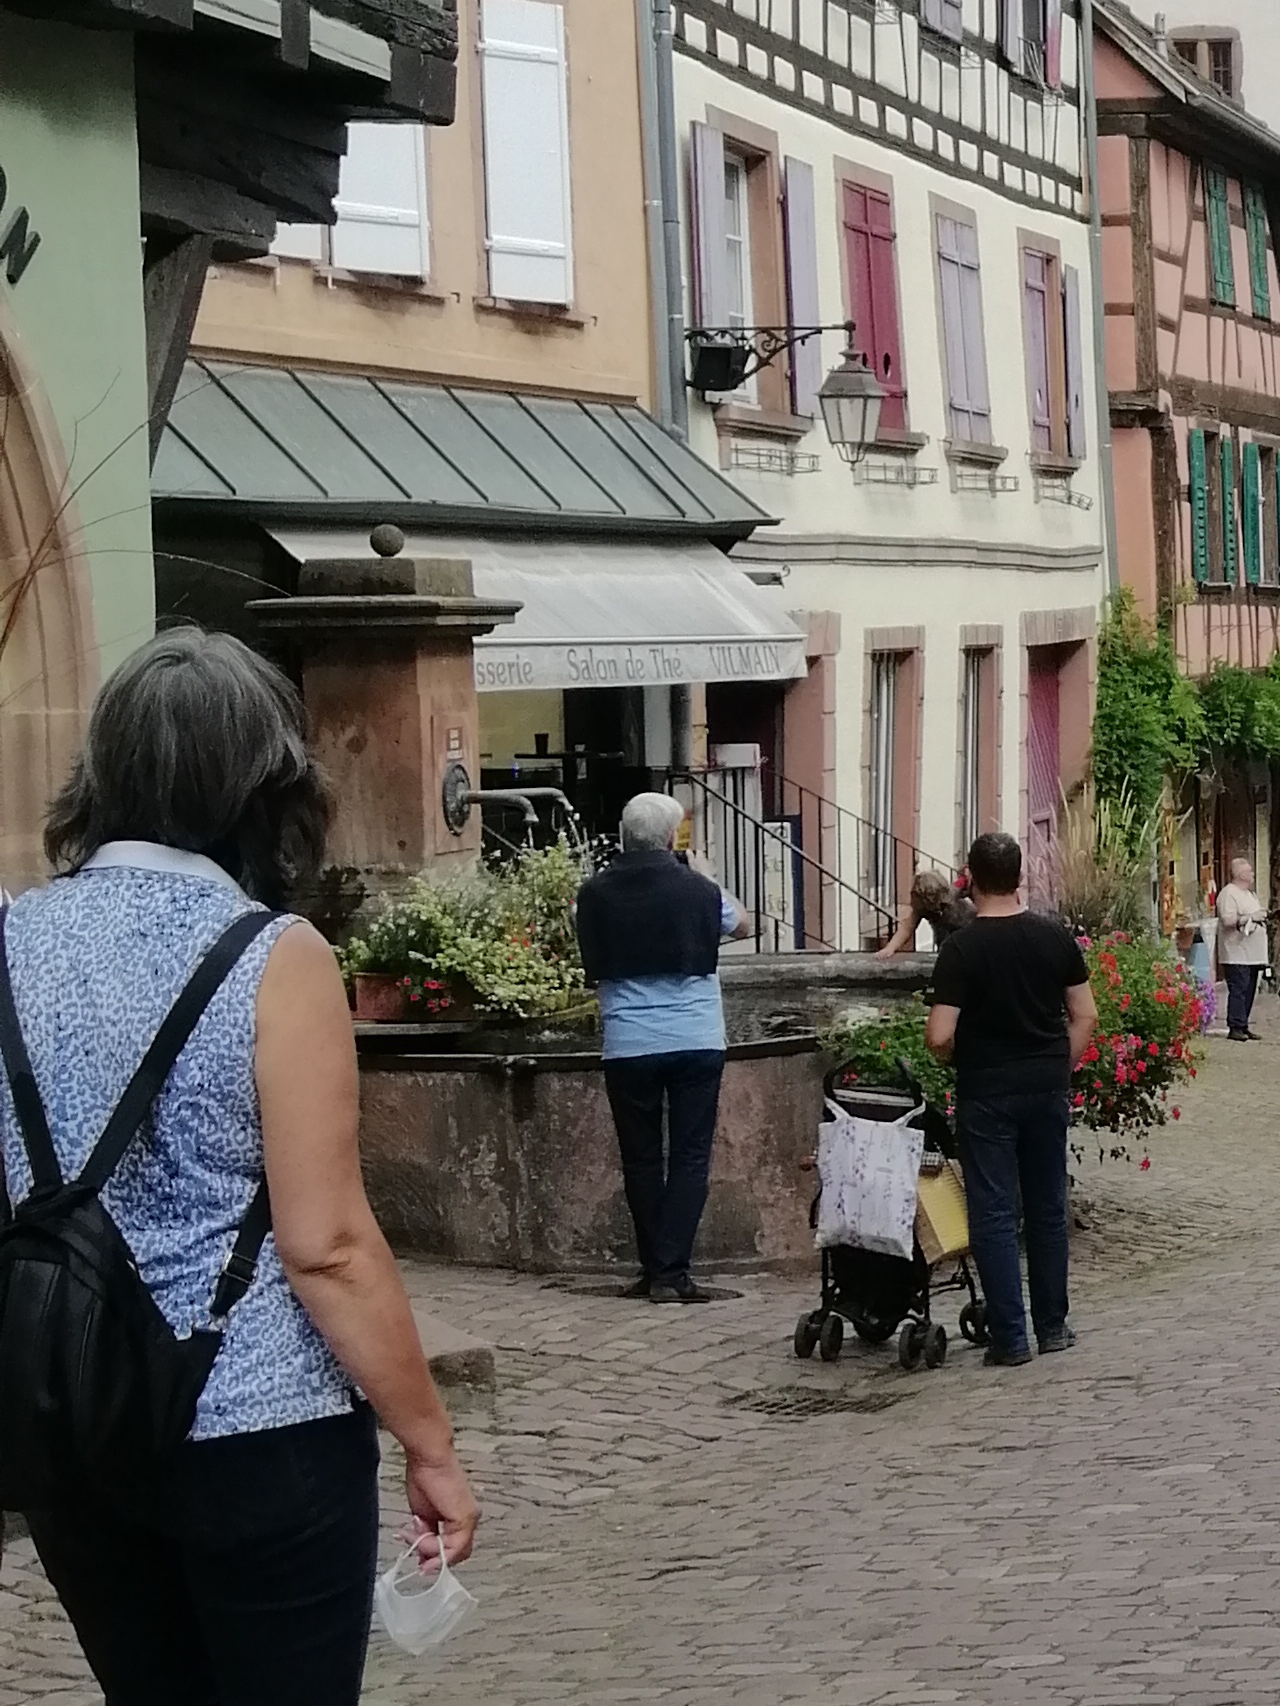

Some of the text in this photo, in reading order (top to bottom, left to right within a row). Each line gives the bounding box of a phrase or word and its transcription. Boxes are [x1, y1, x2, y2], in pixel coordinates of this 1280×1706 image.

[476, 644, 782, 685] sserie Salon de Thé VILMAIN
